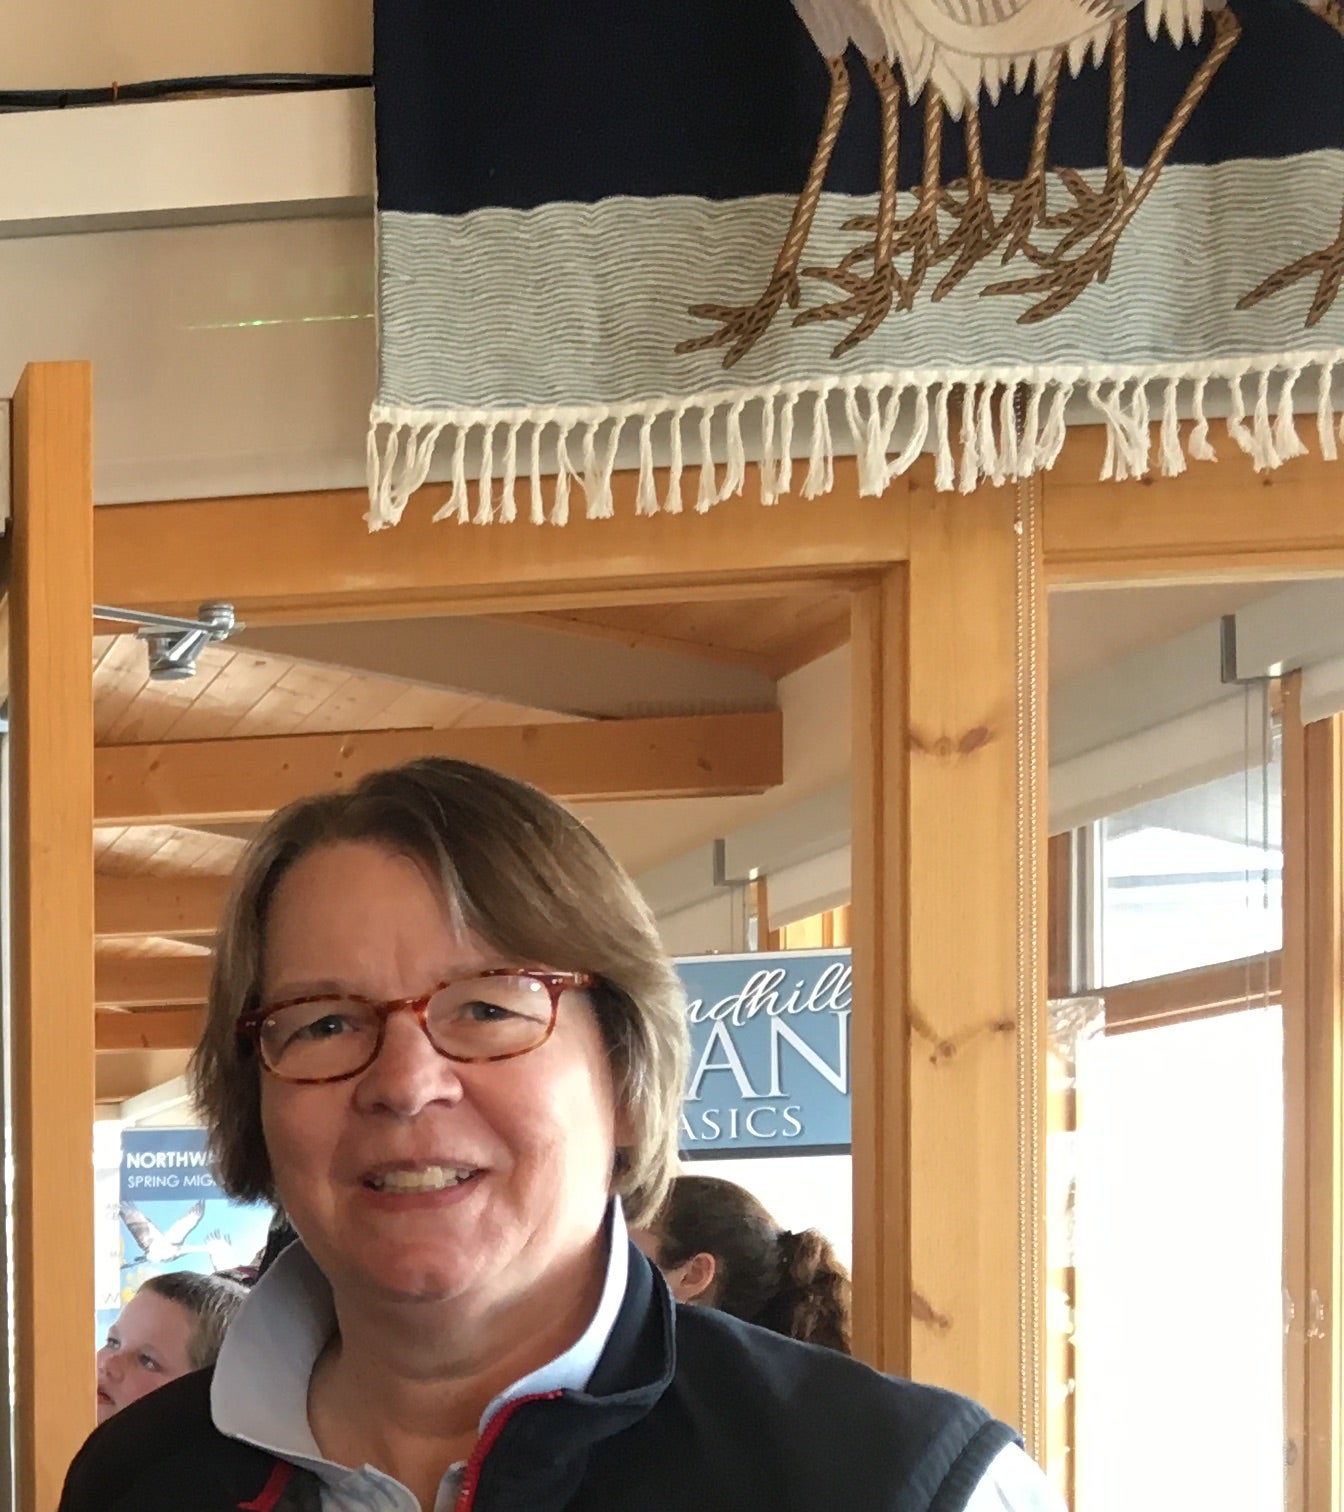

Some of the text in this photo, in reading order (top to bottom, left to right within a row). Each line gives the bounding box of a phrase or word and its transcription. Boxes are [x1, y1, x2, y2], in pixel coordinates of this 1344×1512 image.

[681, 1009, 852, 1100] AN
[680, 1105, 803, 1141] ASICS
[127, 1173, 220, 1189] SPRING MIG
